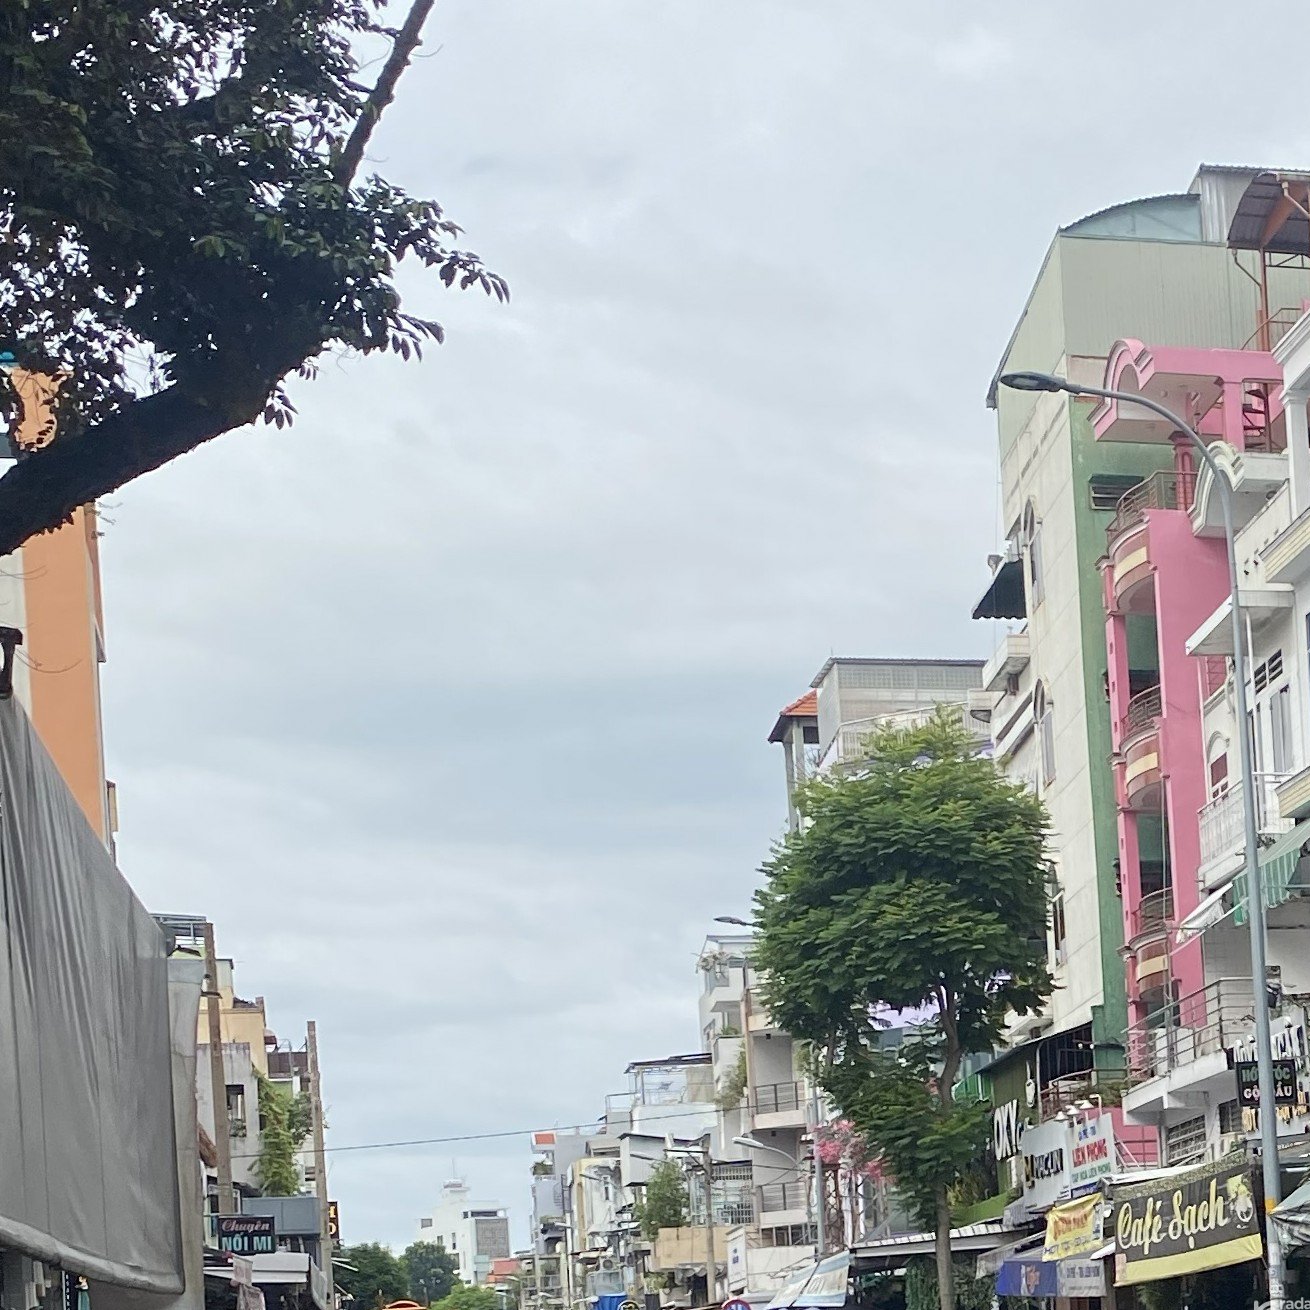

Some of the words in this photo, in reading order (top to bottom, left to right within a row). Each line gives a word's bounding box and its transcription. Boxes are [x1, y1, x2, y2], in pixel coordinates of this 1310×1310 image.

[994, 1099, 1018, 1161] OXY
[221, 1219, 271, 1233] Chuyên
[1117, 1197, 1167, 1255] Café
[1168, 1177, 1229, 1249] Sạch
[221, 1232, 249, 1251] NỐI
[253, 1236, 272, 1251] MI
